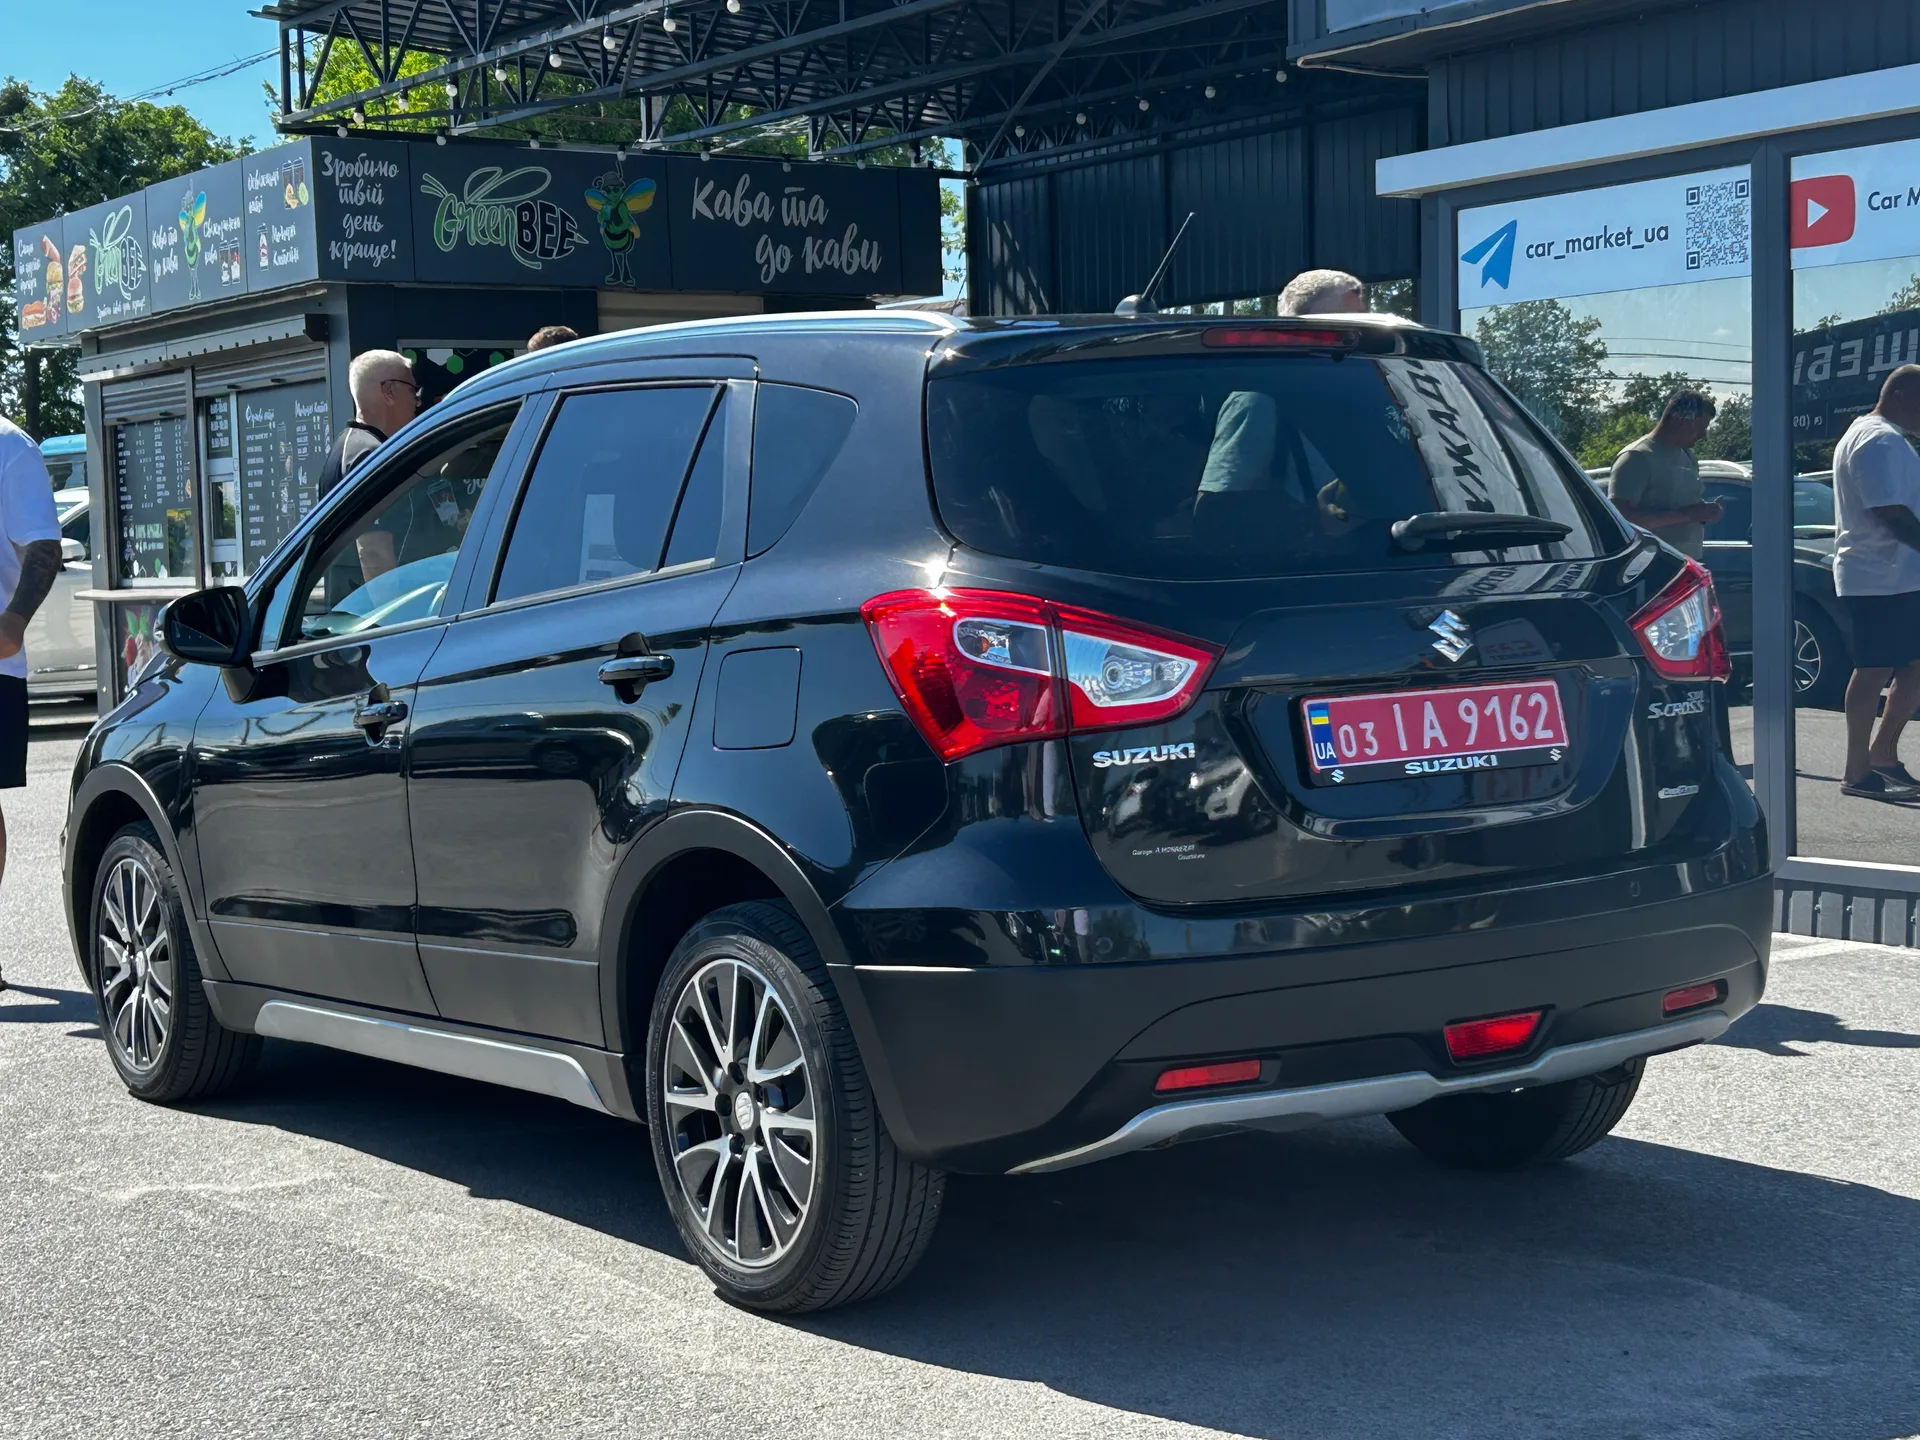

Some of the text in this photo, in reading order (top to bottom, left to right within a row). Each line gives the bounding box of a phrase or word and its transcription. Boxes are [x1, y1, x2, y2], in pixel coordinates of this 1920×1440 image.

[321, 151, 399, 187] Зробимо
[339, 178, 384, 206] твій
[692, 173, 829, 227] Кава та
[1867, 191, 1902, 211] Car
[342, 213, 384, 239] день
[329, 239, 397, 270] краще!
[755, 222, 882, 284] до кави
[1525, 224, 1669, 260] car_market_ua
[1338, 722, 1378, 758] 03
[1458, 692, 1553, 746] 9162
[1092, 742, 1195, 768] SUZUKI
[1315, 742, 1336, 760] UA
[1405, 755, 1498, 775] SUZUKI
